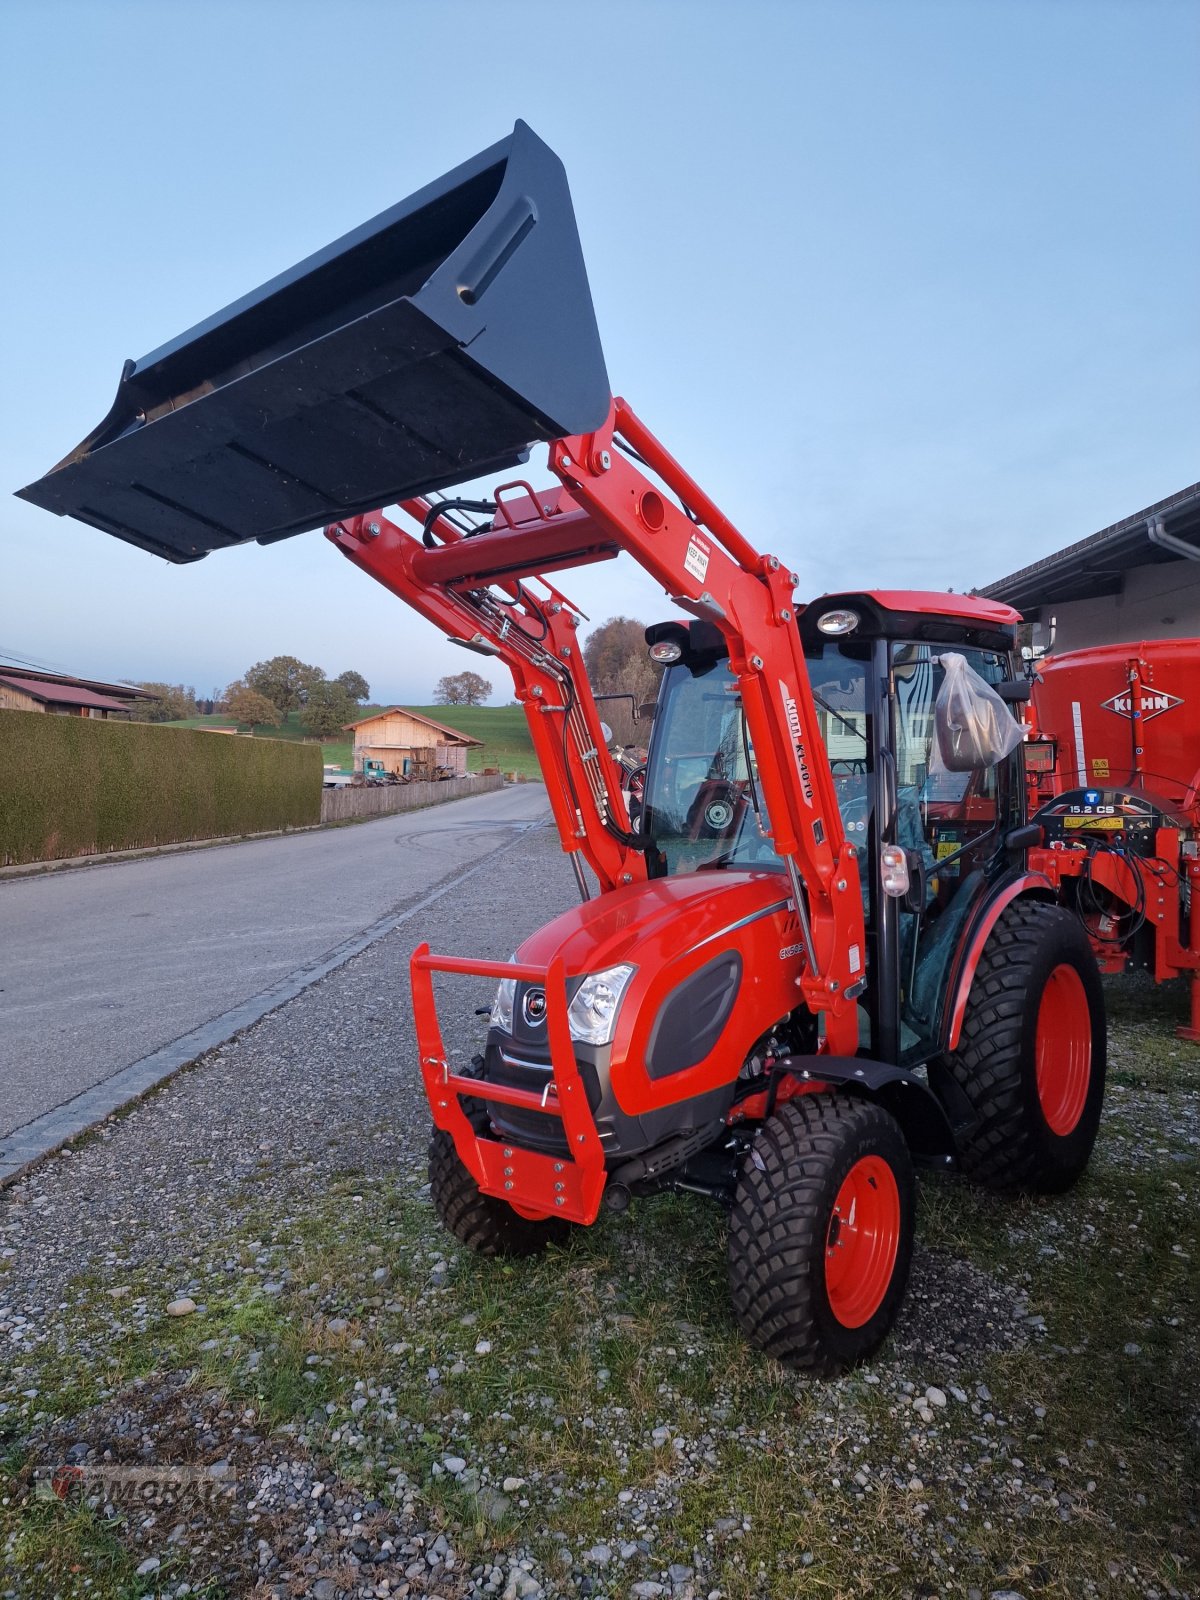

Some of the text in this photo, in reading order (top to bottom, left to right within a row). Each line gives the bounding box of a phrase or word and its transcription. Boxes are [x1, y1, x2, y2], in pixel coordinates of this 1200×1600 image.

[785, 698, 802, 739] KIOTI
[1069, 805, 1115, 814] 15.2 CS
